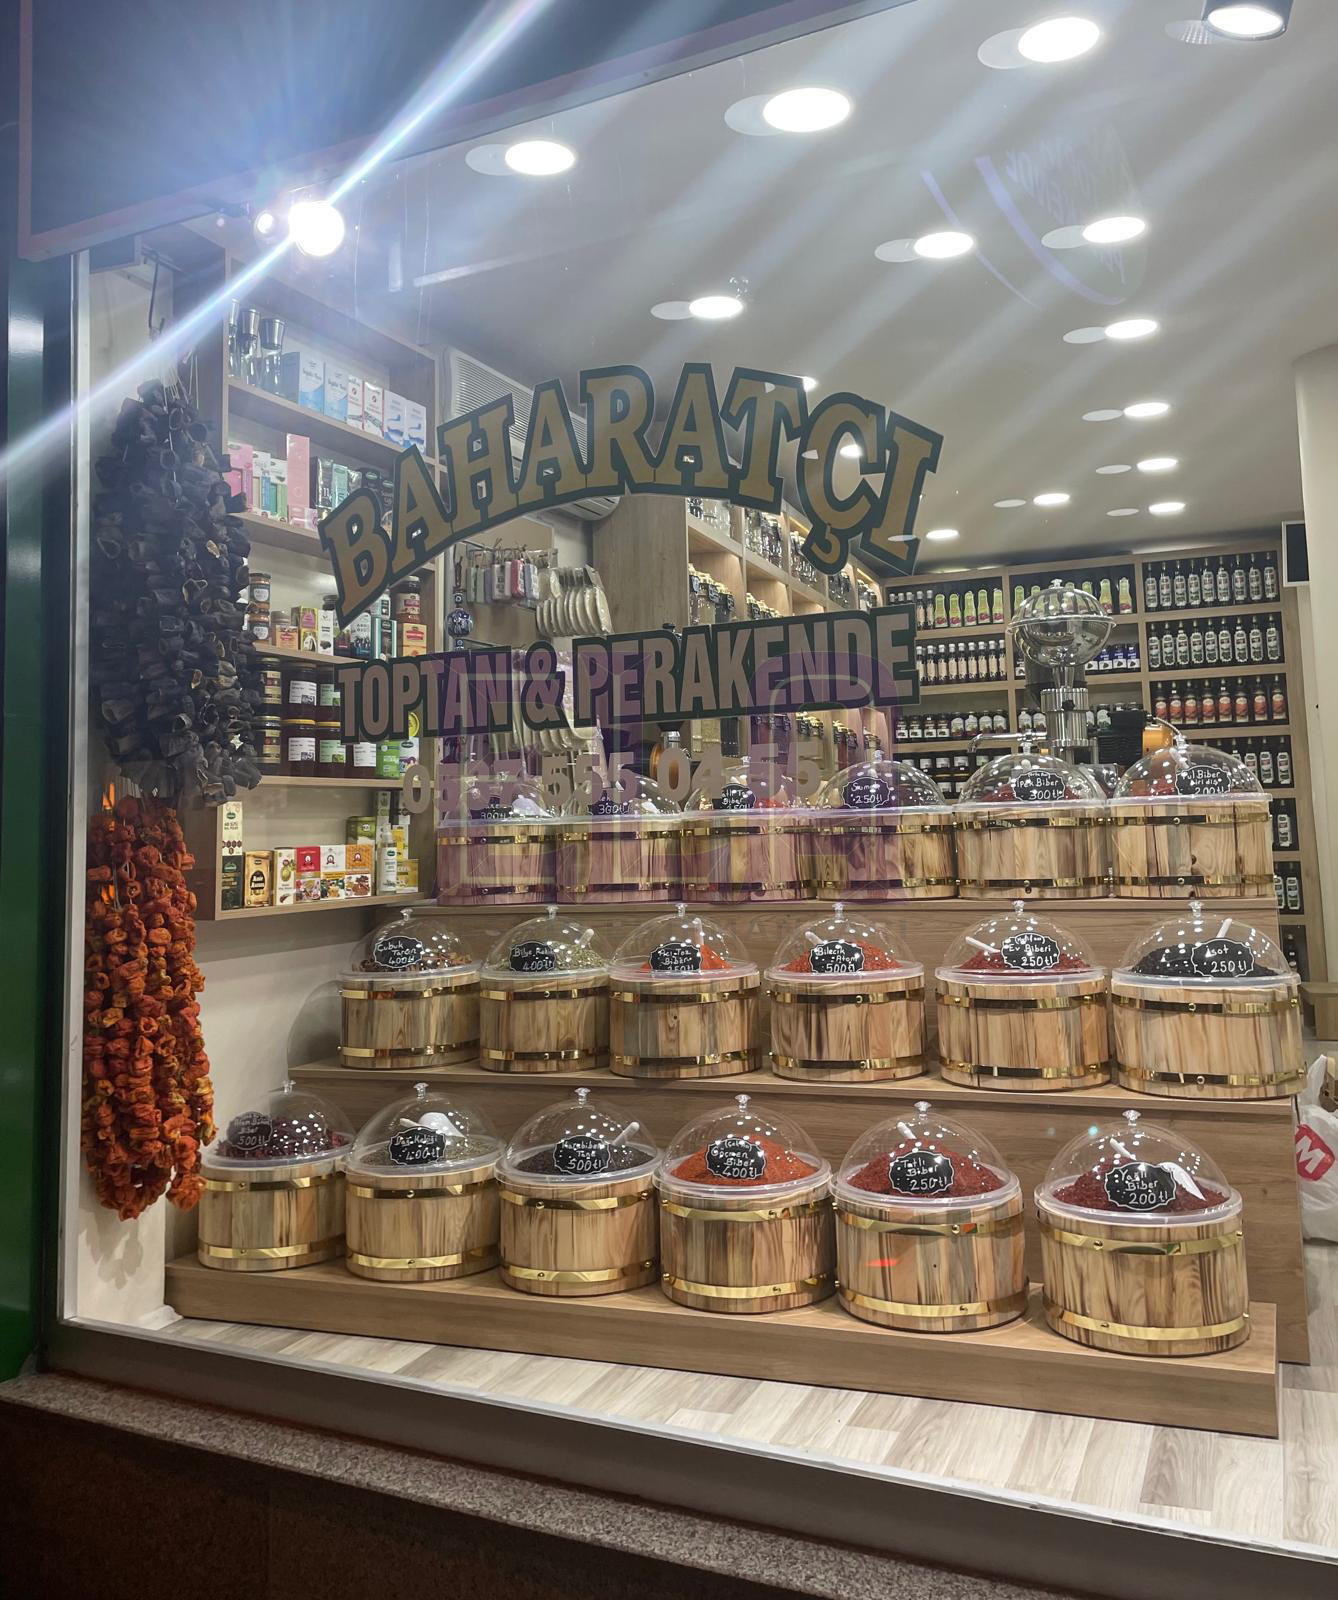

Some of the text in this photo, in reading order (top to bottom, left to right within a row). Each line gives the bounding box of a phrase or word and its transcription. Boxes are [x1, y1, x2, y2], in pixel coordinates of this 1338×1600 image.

[318, 363, 943, 629] BAHARATÇI
[335, 604, 920, 744] TOPTAN & PERAKENDE
[1196, 769, 1220, 779] Biber
[1036, 777, 1058, 787] Biber
[1008, 943, 1021, 952] Ev
[1020, 955, 1053, 967] 250tl
[1210, 960, 1247, 973] 250tl
[567, 1158, 601, 1171] 500tl
[723, 1158, 754, 1167] Biber
[910, 1176, 947, 1190] 250tl
[1126, 1180, 1158, 1191] Biber
[1129, 1191, 1168, 1204] 200tl
